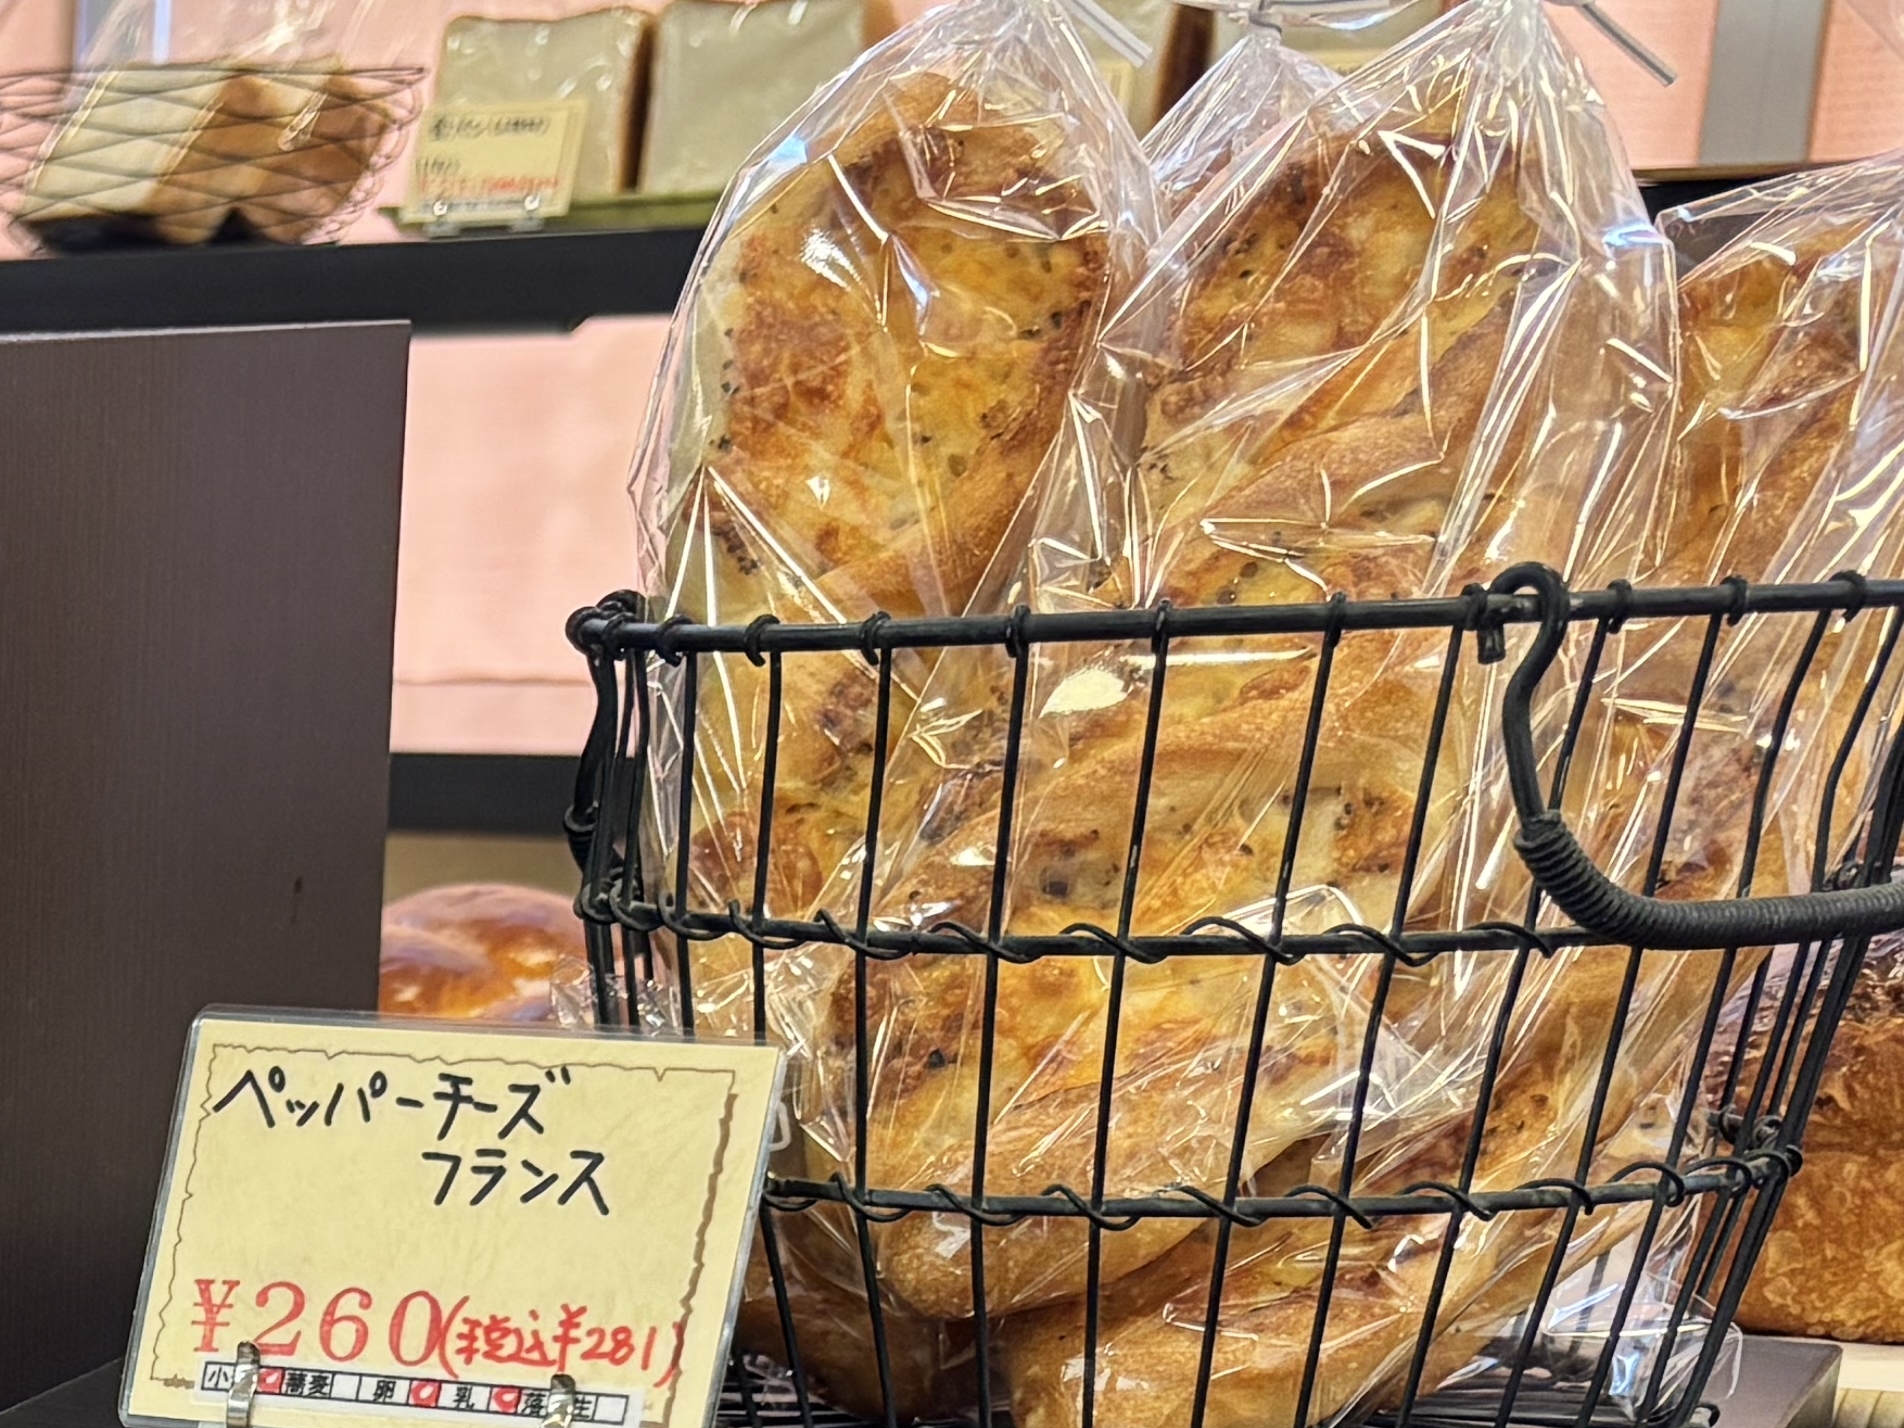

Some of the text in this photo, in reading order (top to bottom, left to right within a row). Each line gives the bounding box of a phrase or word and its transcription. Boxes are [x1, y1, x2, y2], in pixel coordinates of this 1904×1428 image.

[213, 1065, 571, 1141] ペッパーチーズ
[421, 1150, 610, 1215] フランス
[521, 1392, 592, 1421] 落生
